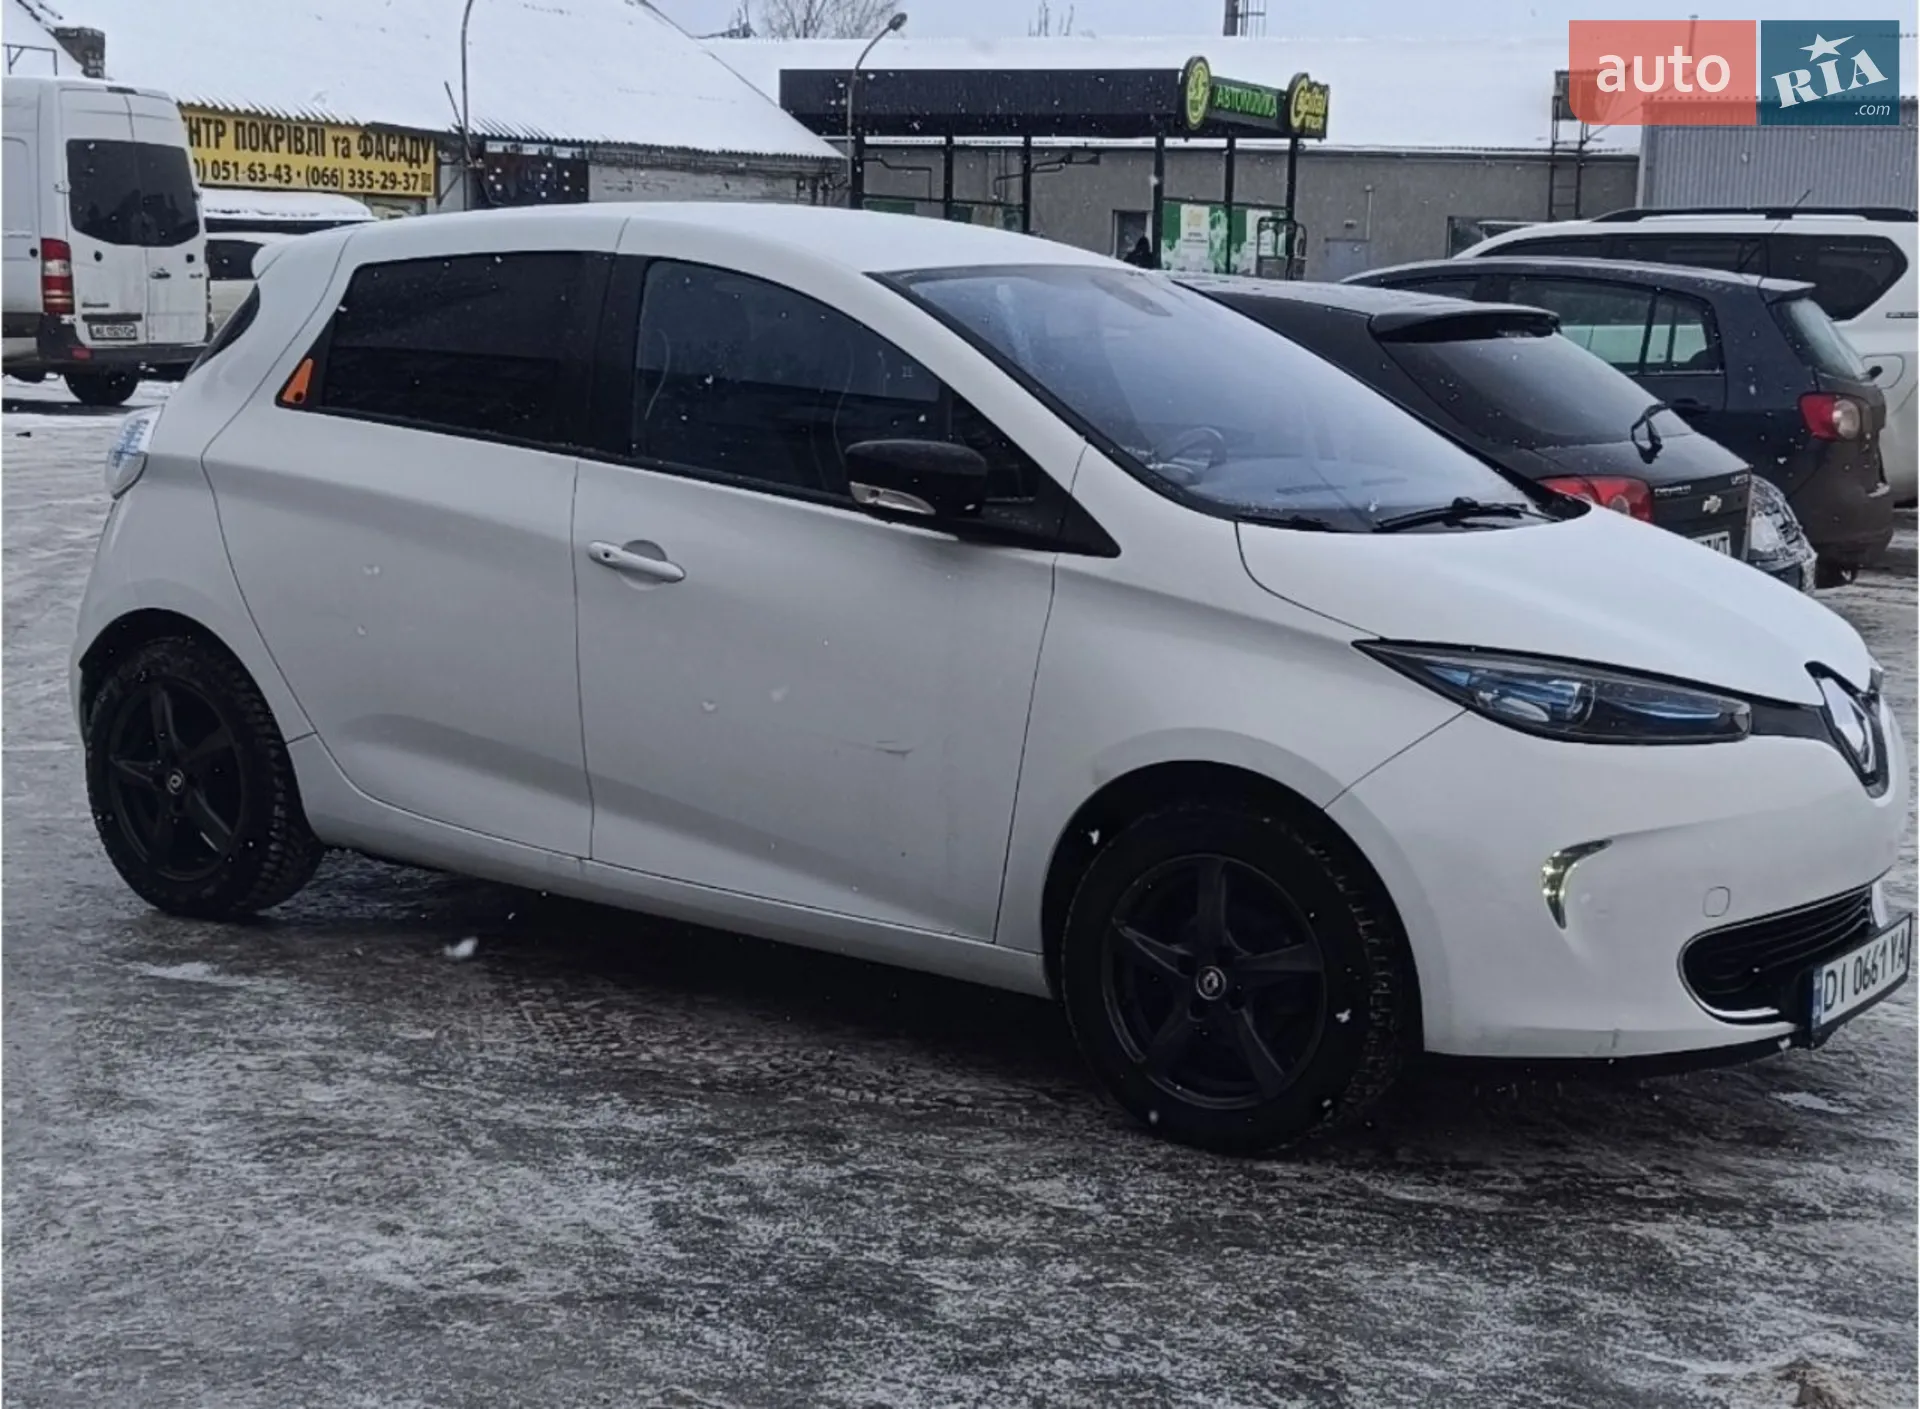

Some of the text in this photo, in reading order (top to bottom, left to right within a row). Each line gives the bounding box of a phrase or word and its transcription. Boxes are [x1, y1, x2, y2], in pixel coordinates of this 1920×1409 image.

[182, 113, 432, 169] НТР ПОКРІВЛІ та ФАСАДУ
[305, 163, 344, 188] (066)
[348, 168, 419, 191] 335-29-37
[1824, 961, 1847, 1013] DI
[1853, 940, 1887, 996] 0661
